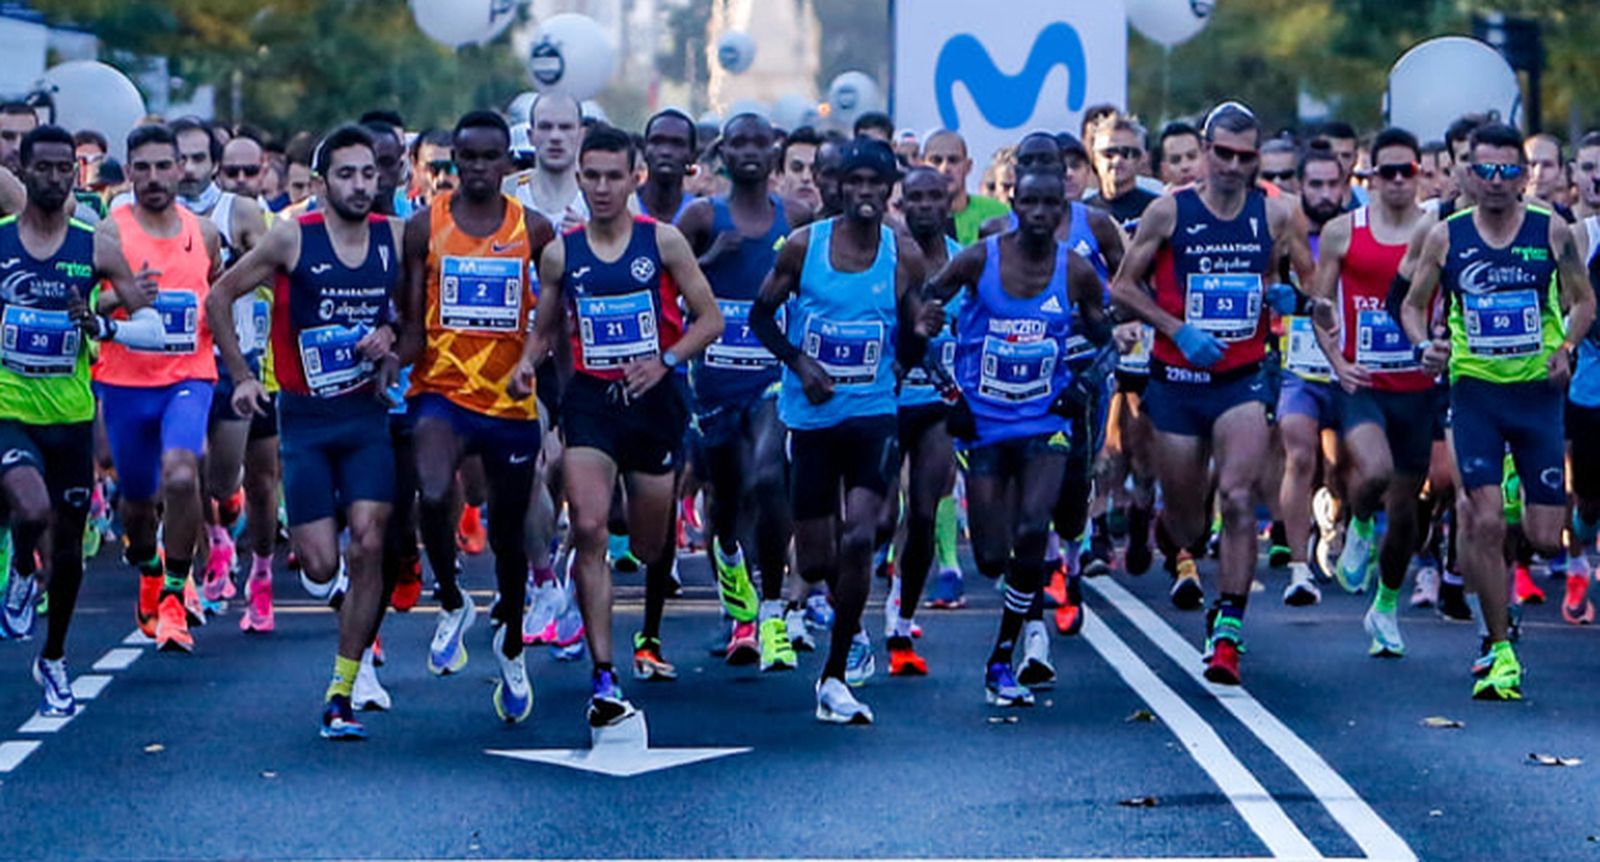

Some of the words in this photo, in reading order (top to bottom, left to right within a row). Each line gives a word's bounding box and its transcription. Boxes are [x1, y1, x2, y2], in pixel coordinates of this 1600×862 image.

[476, 283, 487, 297] 2
[1216, 298, 1233, 311] 53
[605, 322, 624, 336] 21
[1493, 315, 1511, 329] 50
[741, 325, 750, 339] 7
[31, 334, 49, 347] 30
[334, 347, 352, 361] 51
[835, 346, 850, 358] 13
